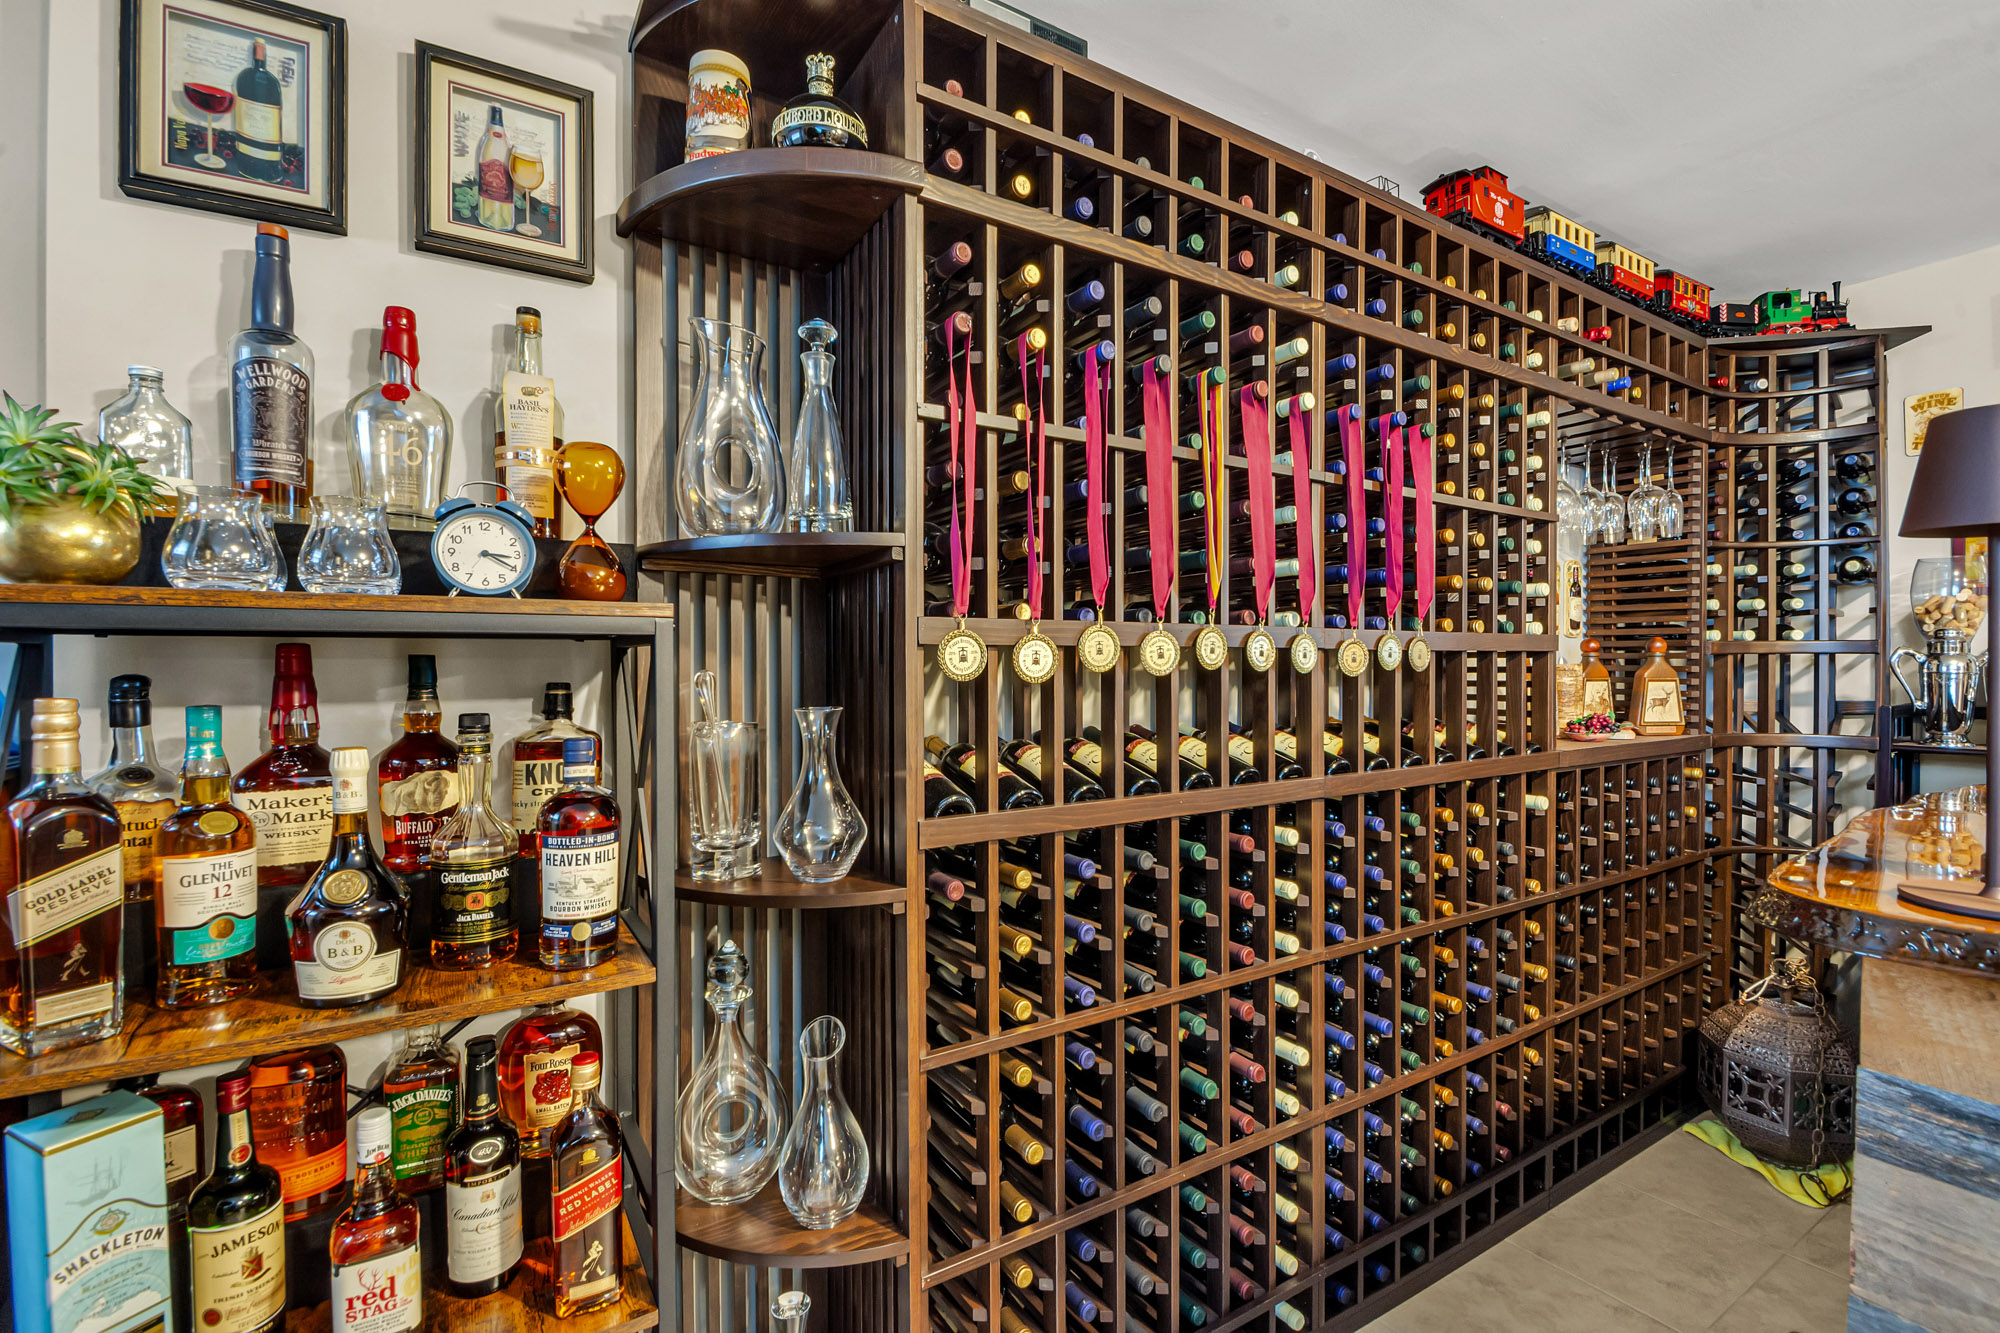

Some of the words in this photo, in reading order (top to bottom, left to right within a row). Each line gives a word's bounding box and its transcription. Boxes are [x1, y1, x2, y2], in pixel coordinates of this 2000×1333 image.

[236, 362, 307, 390] WELLWOOD
[245, 376, 296, 396] GARDENS
[517, 398, 539, 407] BASIL
[1910, 397, 1958, 413] WINE
[252, 438, 287, 450] Wheated
[374, 431, 423, 468] 46
[462, 525, 472, 535] 11
[478, 521, 492, 532] 12
[499, 526, 504, 536] 1
[449, 535, 463, 545] 10
[509, 537, 518, 547] 2
[447, 547, 456, 557] 9
[513, 550, 521, 560] 3
[451, 562, 460, 572] 8
[510, 564, 518, 574] 4
[465, 572, 474, 583] 7
[481, 577, 490, 587] 6
[498, 573, 507, 584] 5
[525, 762, 564, 786] KNO
[247, 794, 333, 811] Maker's
[123, 817, 160, 832] ntuck
[271, 809, 333, 826] Mark
[264, 828, 322, 840] WHISKY
[395, 820, 434, 836] BUFFALO
[547, 832, 615, 846] BOTTLED-IN-BOND
[546, 852, 591, 867] HEAVEN
[595, 848, 616, 865] HILL
[210, 860, 234, 872] THE
[180, 864, 254, 888] GLENLIVET
[441, 871, 492, 884] Gentleman
[491, 866, 510, 883] Jack
[25, 887, 66, 910] GOLD
[68, 866, 117, 893] LABEL
[212, 883, 233, 900] 12
[35, 877, 114, 915] RESERVE
[584, 896, 607, 905] STRAIGHT
[549, 904, 582, 913] BOURBON
[584, 900, 612, 911] WHISKEY
[456, 914, 472, 922] JACK
[335, 938, 356, 946] DOM
[327, 948, 338, 959] B
[340, 947, 350, 957] &
[353, 944, 364, 956] B
[530, 1061, 549, 1073] Four
[392, 1094, 417, 1113] JACK
[416, 1088, 454, 1103] DANIEL'S
[554, 1102, 570, 1111] BATCH
[364, 1149, 377, 1159] JIM
[377, 1143, 390, 1153] BEAM
[397, 1143, 443, 1160] WHISKE
[295, 1160, 336, 1180] BOURBON
[467, 1170, 508, 1188] IMPORTED
[559, 1199, 582, 1217] RED
[584, 1177, 618, 1203] LABEL
[562, 1186, 588, 1205] JOHNNIE
[451, 1202, 501, 1221] Canadian
[211, 1219, 282, 1259] JAMESON
[53, 1226, 166, 1285] SHACKLETON
[213, 1292, 244, 1304] IRISH
[345, 1275, 398, 1312] red
[345, 1299, 398, 1324] STAG
